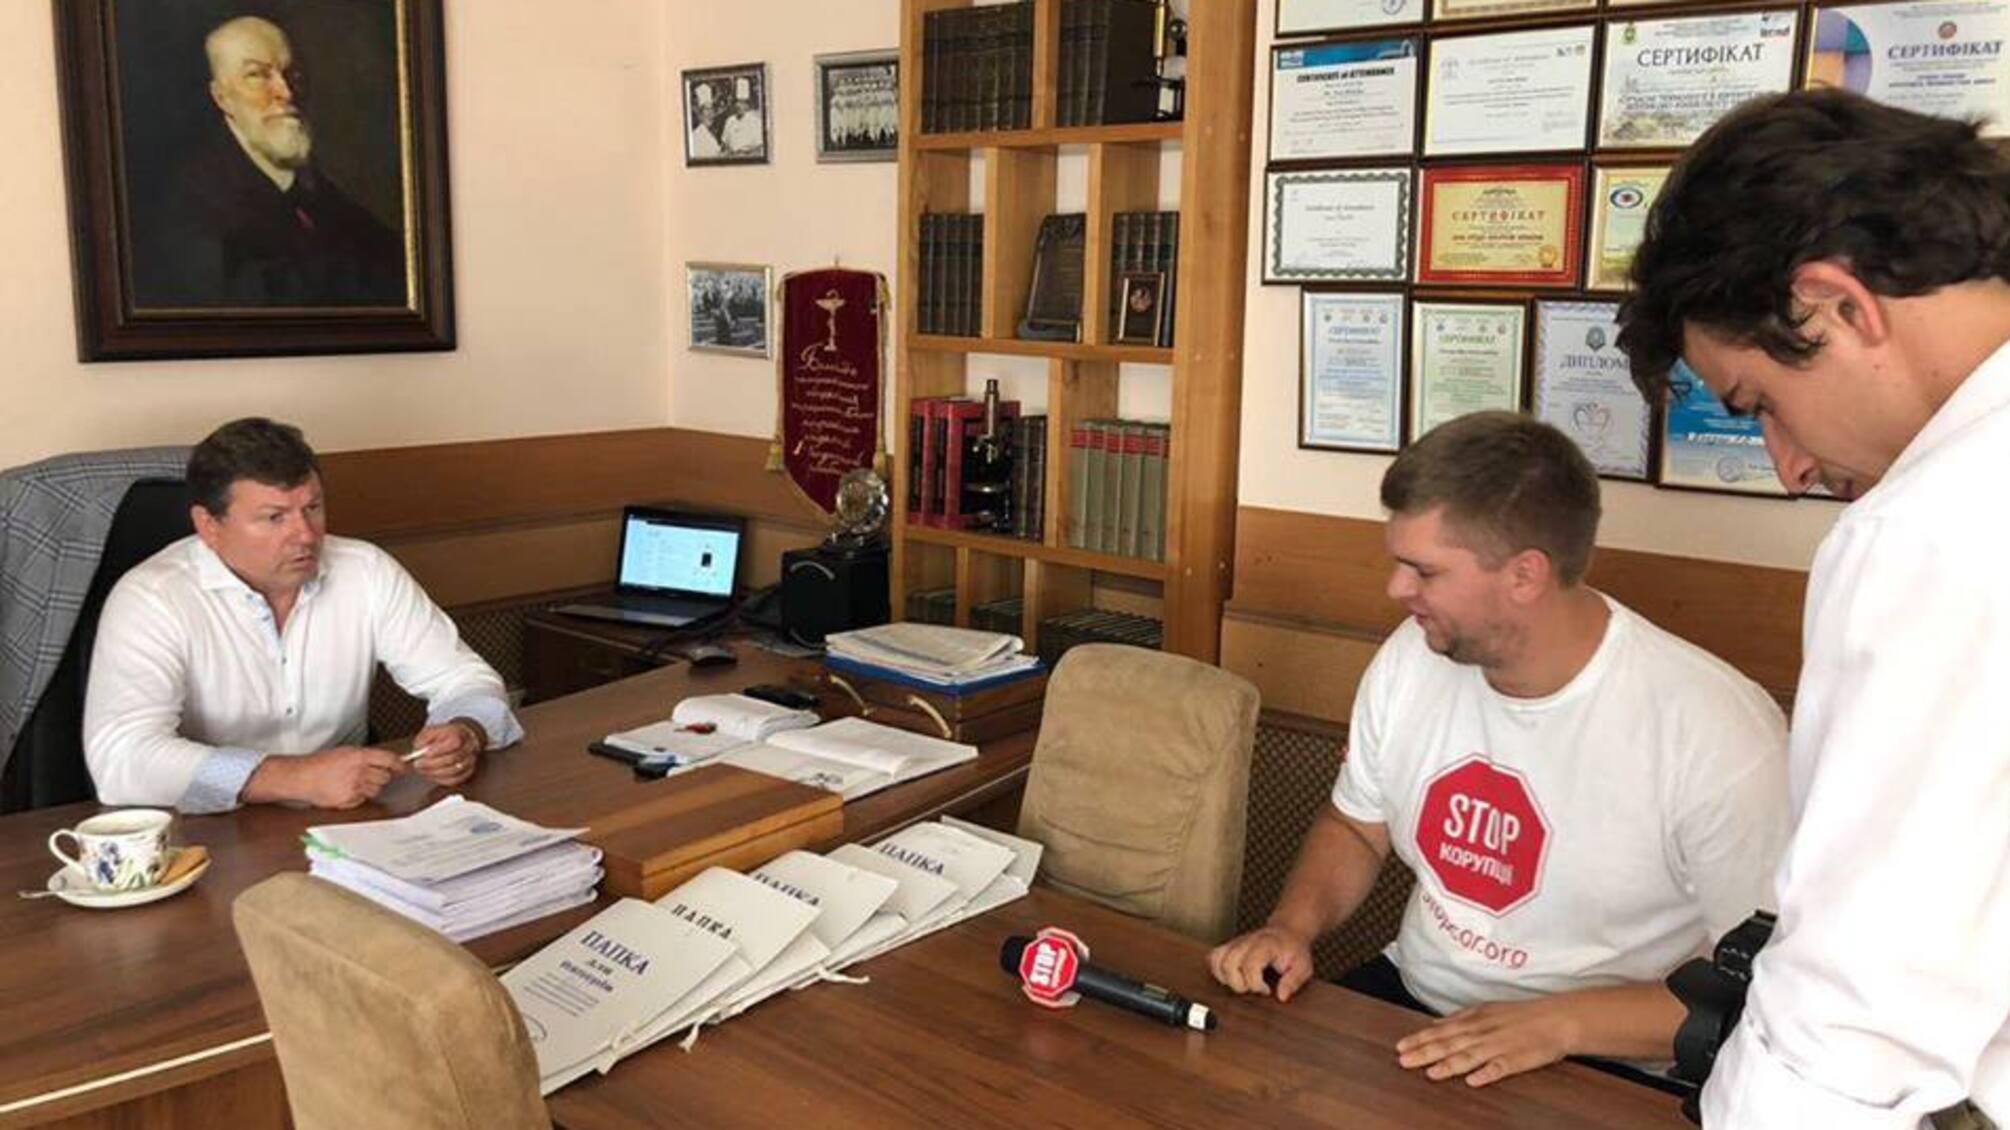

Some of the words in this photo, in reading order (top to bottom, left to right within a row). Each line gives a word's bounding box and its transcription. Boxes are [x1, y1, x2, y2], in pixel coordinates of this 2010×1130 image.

[1637, 43, 1765, 67] СЕРТИФІКАТ
[1887, 40, 2003, 60] СЕРТИФІКАТ
[1451, 209, 1545, 222] СЕРТИФІКАТ
[1560, 354, 1630, 371] ДИПЛОМ
[1443, 792, 1521, 856] STOP
[880, 842, 944, 876] ПАПКА
[754, 871, 820, 907] ПАПКА
[671, 903, 733, 940] ПАПКА
[581, 930, 650, 976] ПАПКА
